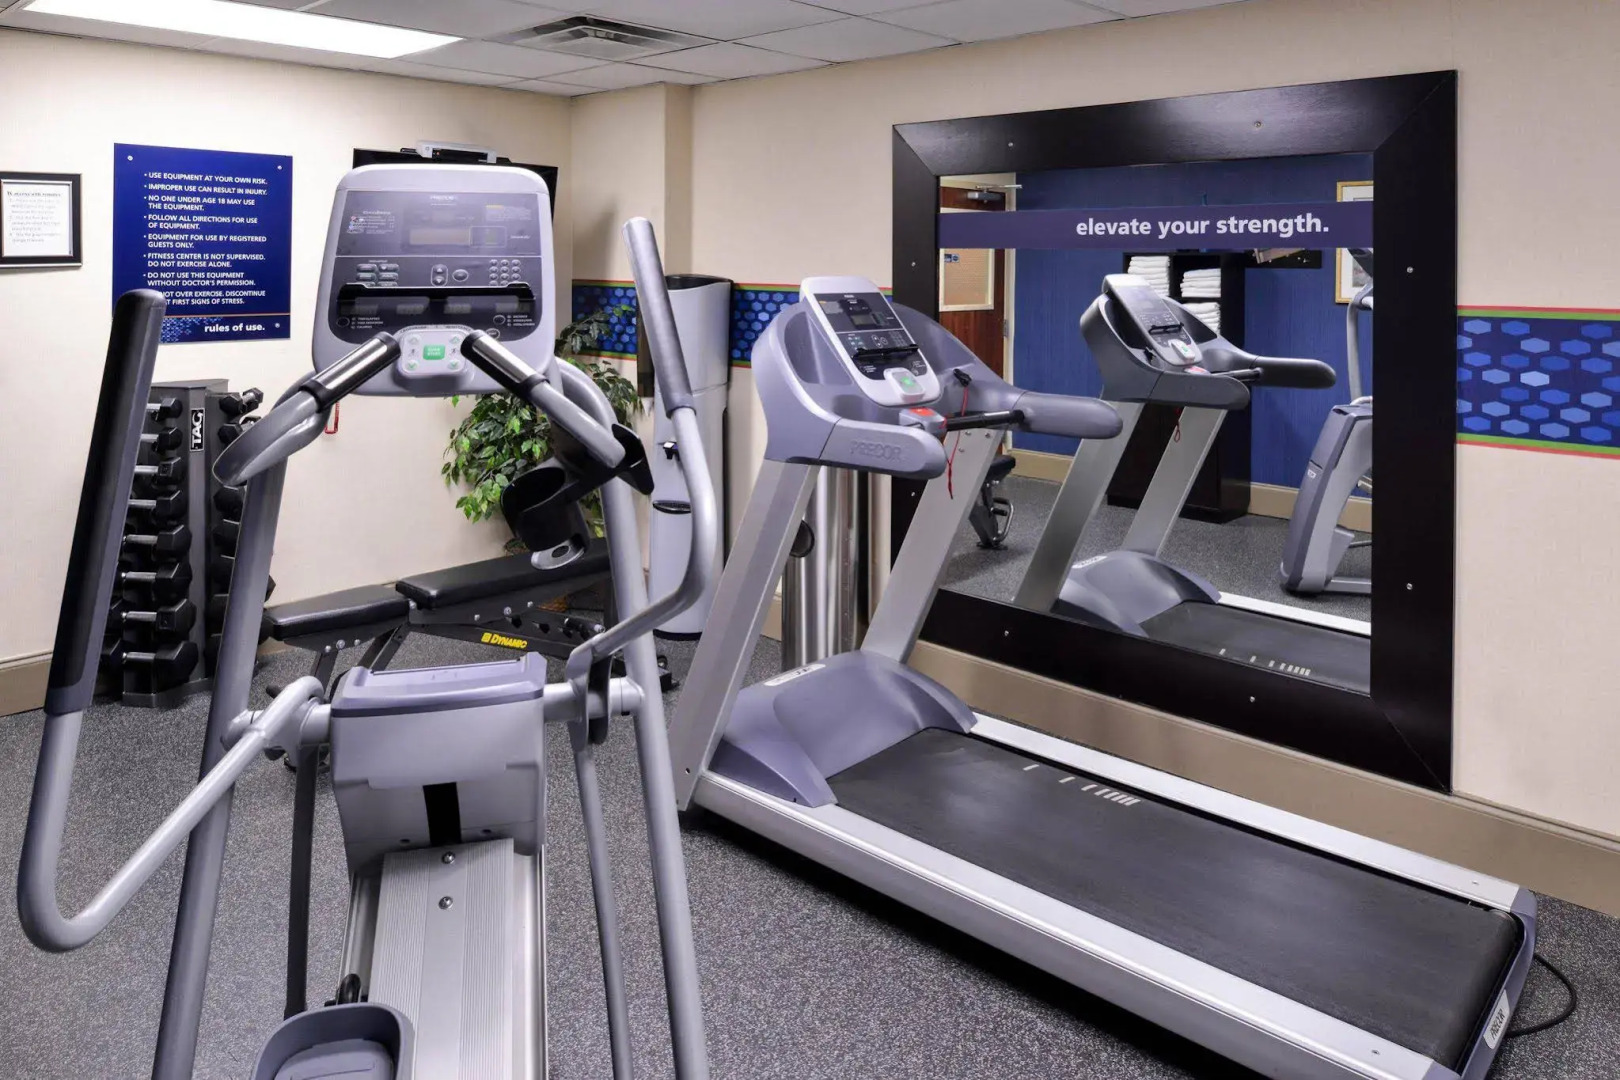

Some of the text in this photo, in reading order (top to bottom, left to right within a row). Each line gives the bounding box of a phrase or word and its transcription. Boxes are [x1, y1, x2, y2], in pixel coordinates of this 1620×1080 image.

[1076, 213, 1329, 239] elevate your strength.
[204, 324, 229, 332] rules
[490, 634, 527, 648] DYNAMIC
